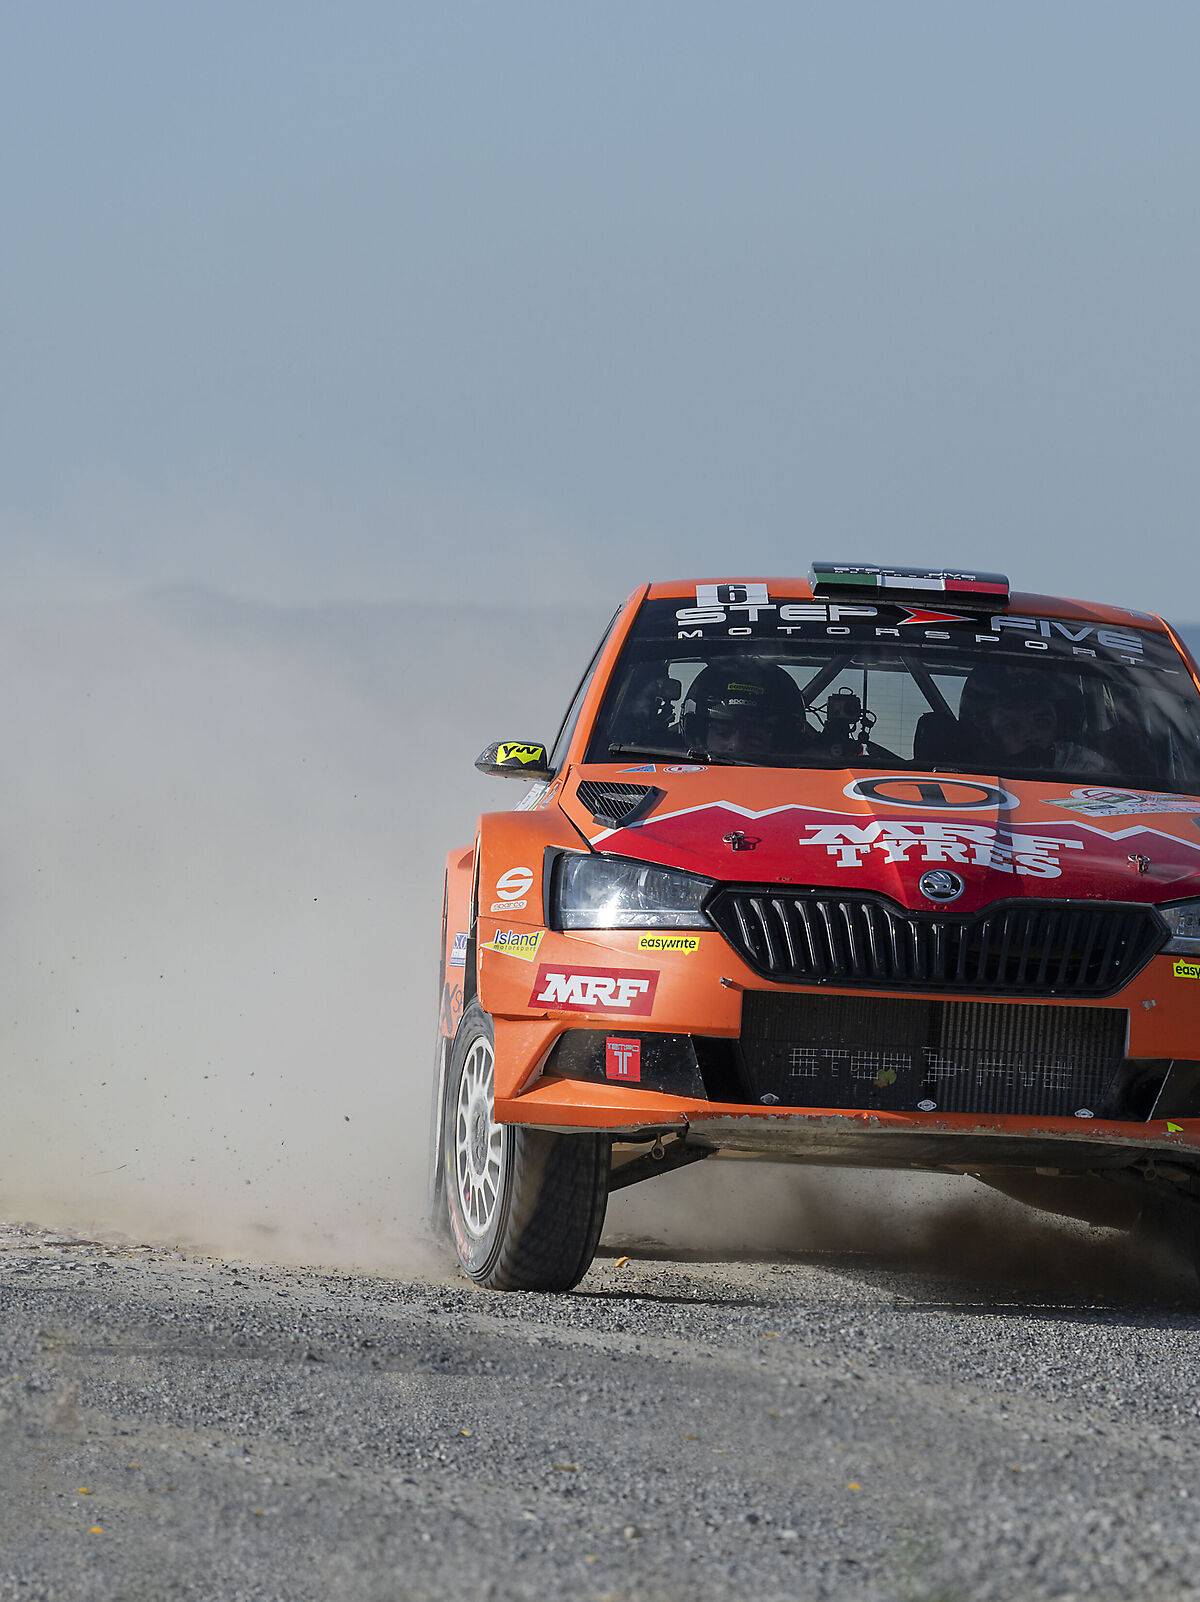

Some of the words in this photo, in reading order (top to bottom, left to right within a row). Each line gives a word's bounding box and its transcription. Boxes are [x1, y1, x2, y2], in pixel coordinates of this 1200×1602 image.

[717, 584, 748, 604] 6
[675, 604, 878, 627] STEP
[990, 616, 1144, 655] FIVE
[677, 626, 1145, 665] MOTORSPORT
[799, 821, 1085, 856] MRF
[827, 840, 1062, 878] TYRES
[493, 944, 537, 952] motorsport
[494, 929, 539, 946] Island
[640, 937, 697, 951] easywrite
[536, 973, 650, 1008] MRF
